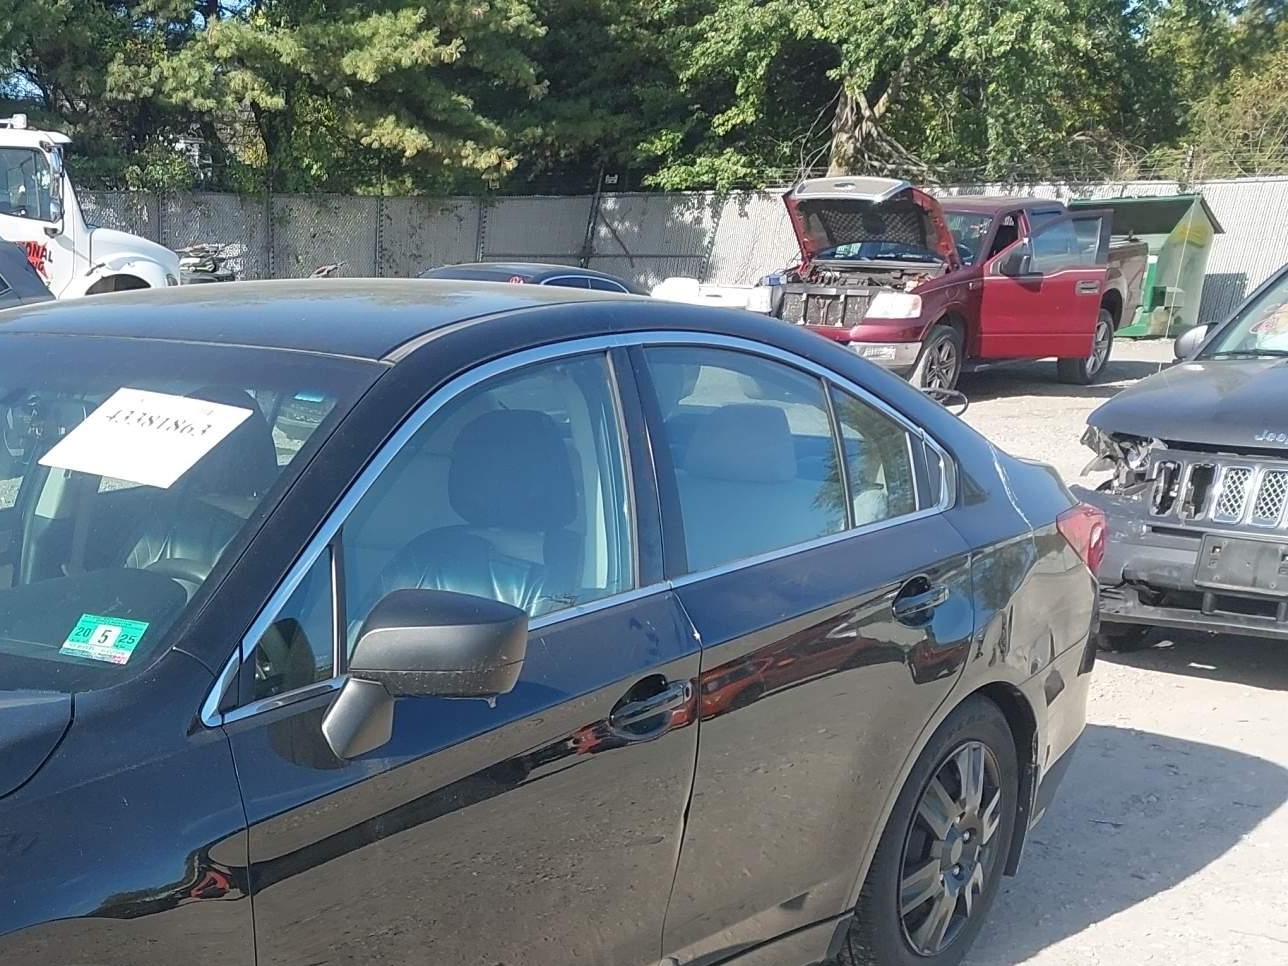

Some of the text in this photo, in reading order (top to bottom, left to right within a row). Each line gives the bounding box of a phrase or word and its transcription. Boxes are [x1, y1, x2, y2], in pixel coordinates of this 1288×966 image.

[106, 409, 213, 437] 43381863
[1254, 429, 1288, 445] Jee
[74, 626, 137, 645] 20 5 25
